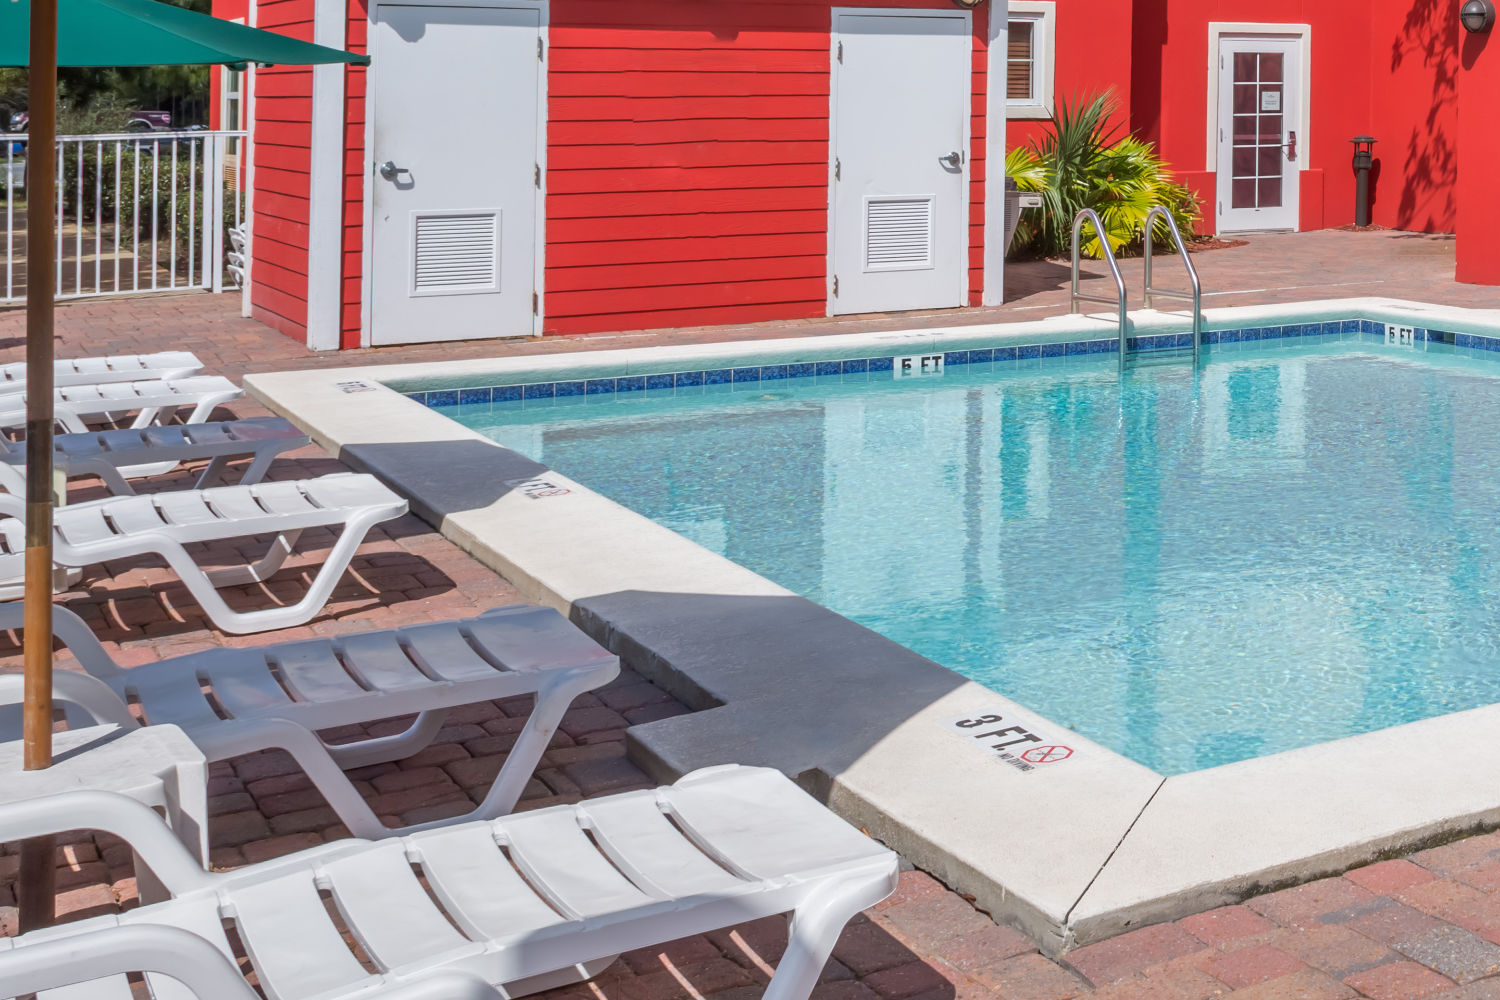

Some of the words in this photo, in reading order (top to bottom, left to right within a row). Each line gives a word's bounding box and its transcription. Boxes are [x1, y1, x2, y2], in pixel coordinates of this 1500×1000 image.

[1400, 328, 1412, 340] FT
[901, 358, 912, 370] 5
[921, 355, 942, 369] FT
[955, 714, 1003, 728] 3
[973, 725, 1043, 751] FT.
